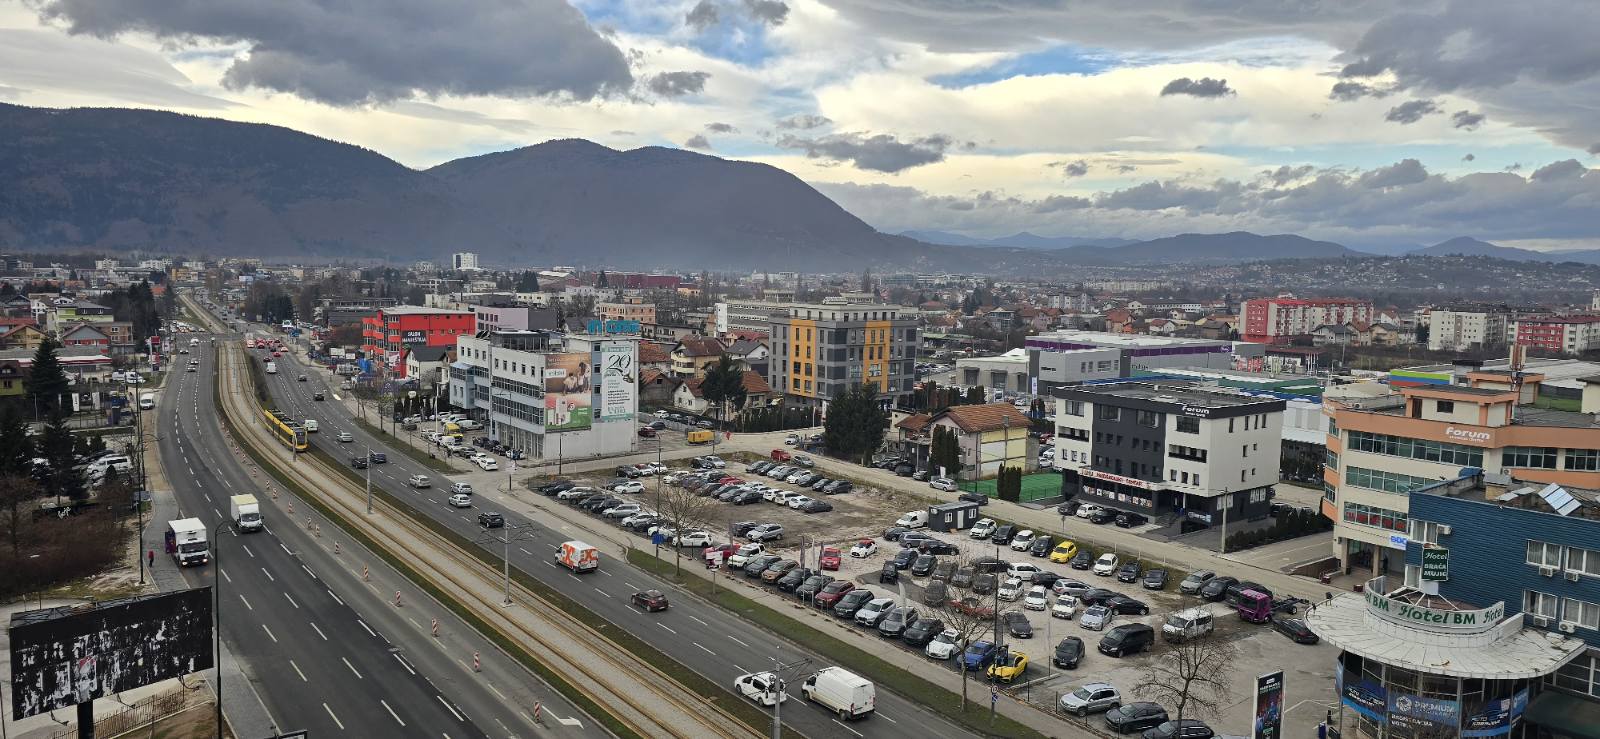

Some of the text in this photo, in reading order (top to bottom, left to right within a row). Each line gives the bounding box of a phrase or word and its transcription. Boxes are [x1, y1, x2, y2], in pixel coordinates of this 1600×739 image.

[606, 354, 631, 373] 20
[1182, 404, 1210, 415] Forum
[1446, 426, 1490, 440] Forum
[1424, 552, 1448, 560] Hotel
[1372, 595, 1389, 612] BM
[1398, 604, 1476, 625] Hotel BM
[1415, 700, 1455, 713] PREMIUM
